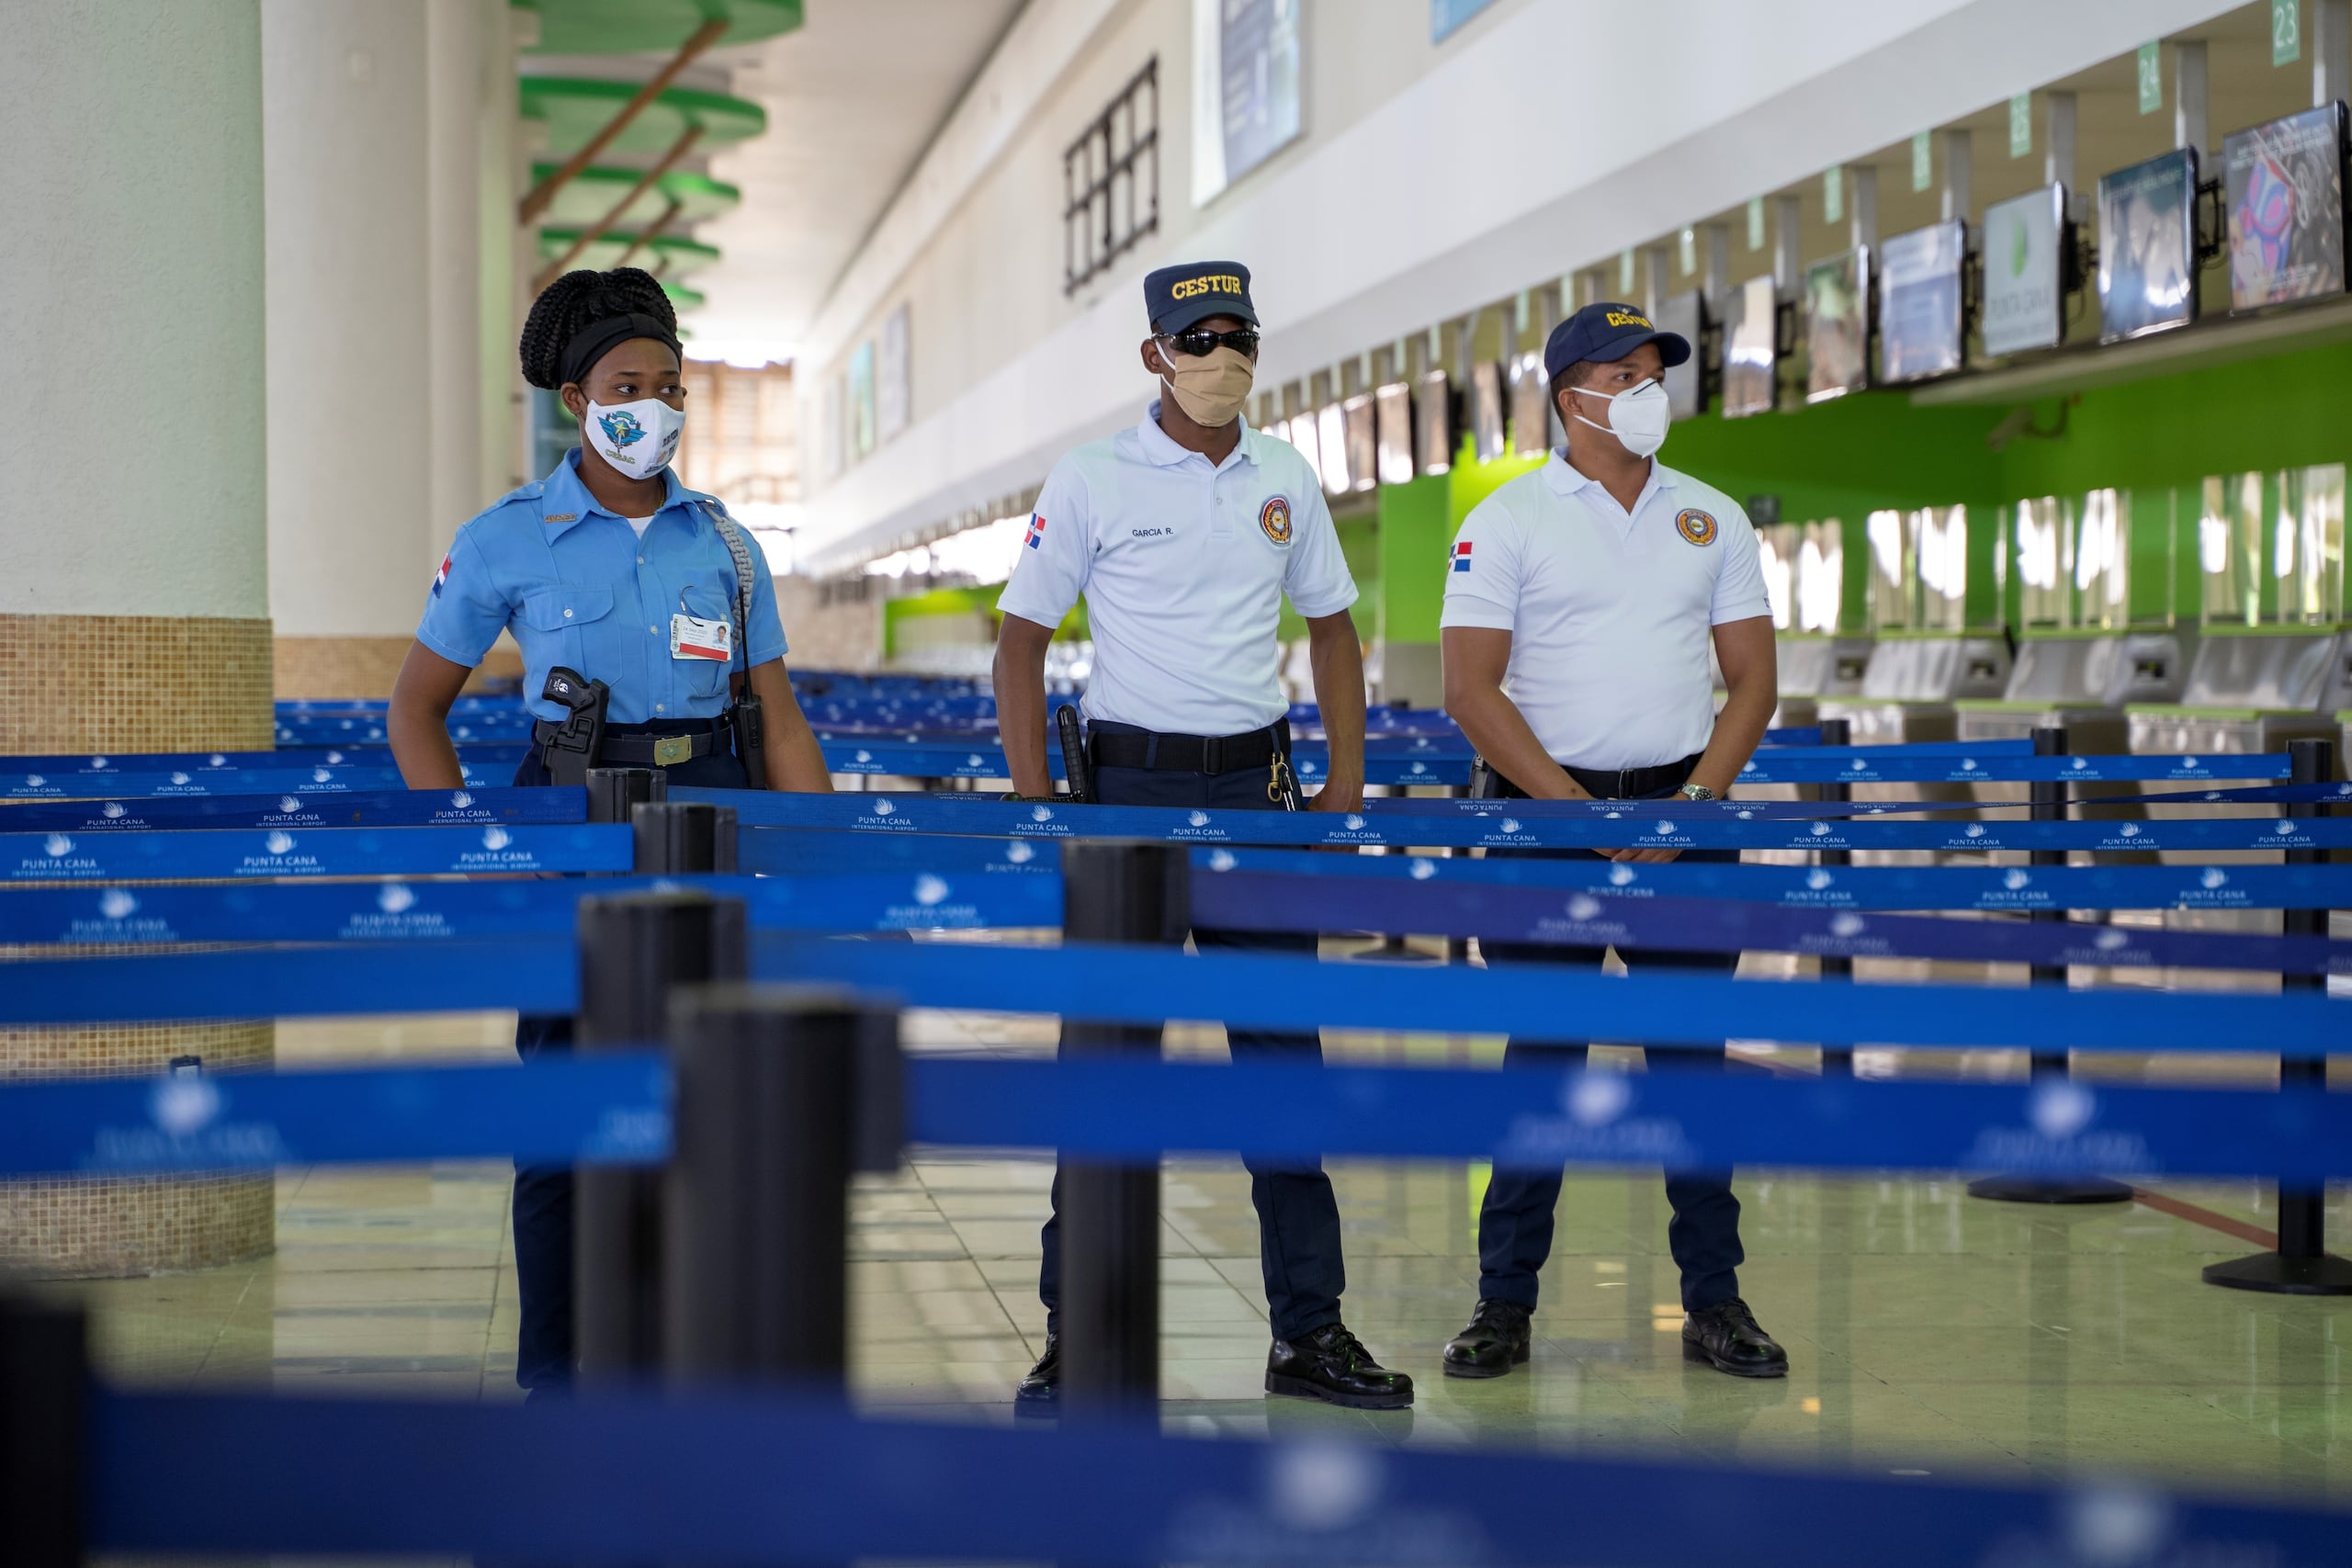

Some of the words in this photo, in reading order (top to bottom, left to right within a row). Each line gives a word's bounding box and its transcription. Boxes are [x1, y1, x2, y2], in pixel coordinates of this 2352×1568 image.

[2273, 4, 2297, 48] 23
[2139, 56, 2159, 96] 24
[1171, 275, 1242, 300] CESTUR
[1132, 529, 1163, 537] GARCIA
[1165, 527, 1174, 536] R.
[243, 857, 283, 866] PUNTA
[286, 856, 318, 865] CANA
[461, 853, 500, 863] PUNTA
[502, 852, 533, 862] CANA
[22, 860, 62, 869] PUNTA
[64, 859, 96, 868] CANA
[1785, 891, 1820, 901] PUNTA
[1823, 891, 1852, 901] CANA
[1983, 892, 2018, 901] PUNTA
[2020, 891, 2049, 901] CANA
[2179, 890, 2214, 899] PUNTA
[2217, 890, 2246, 899] CANA
